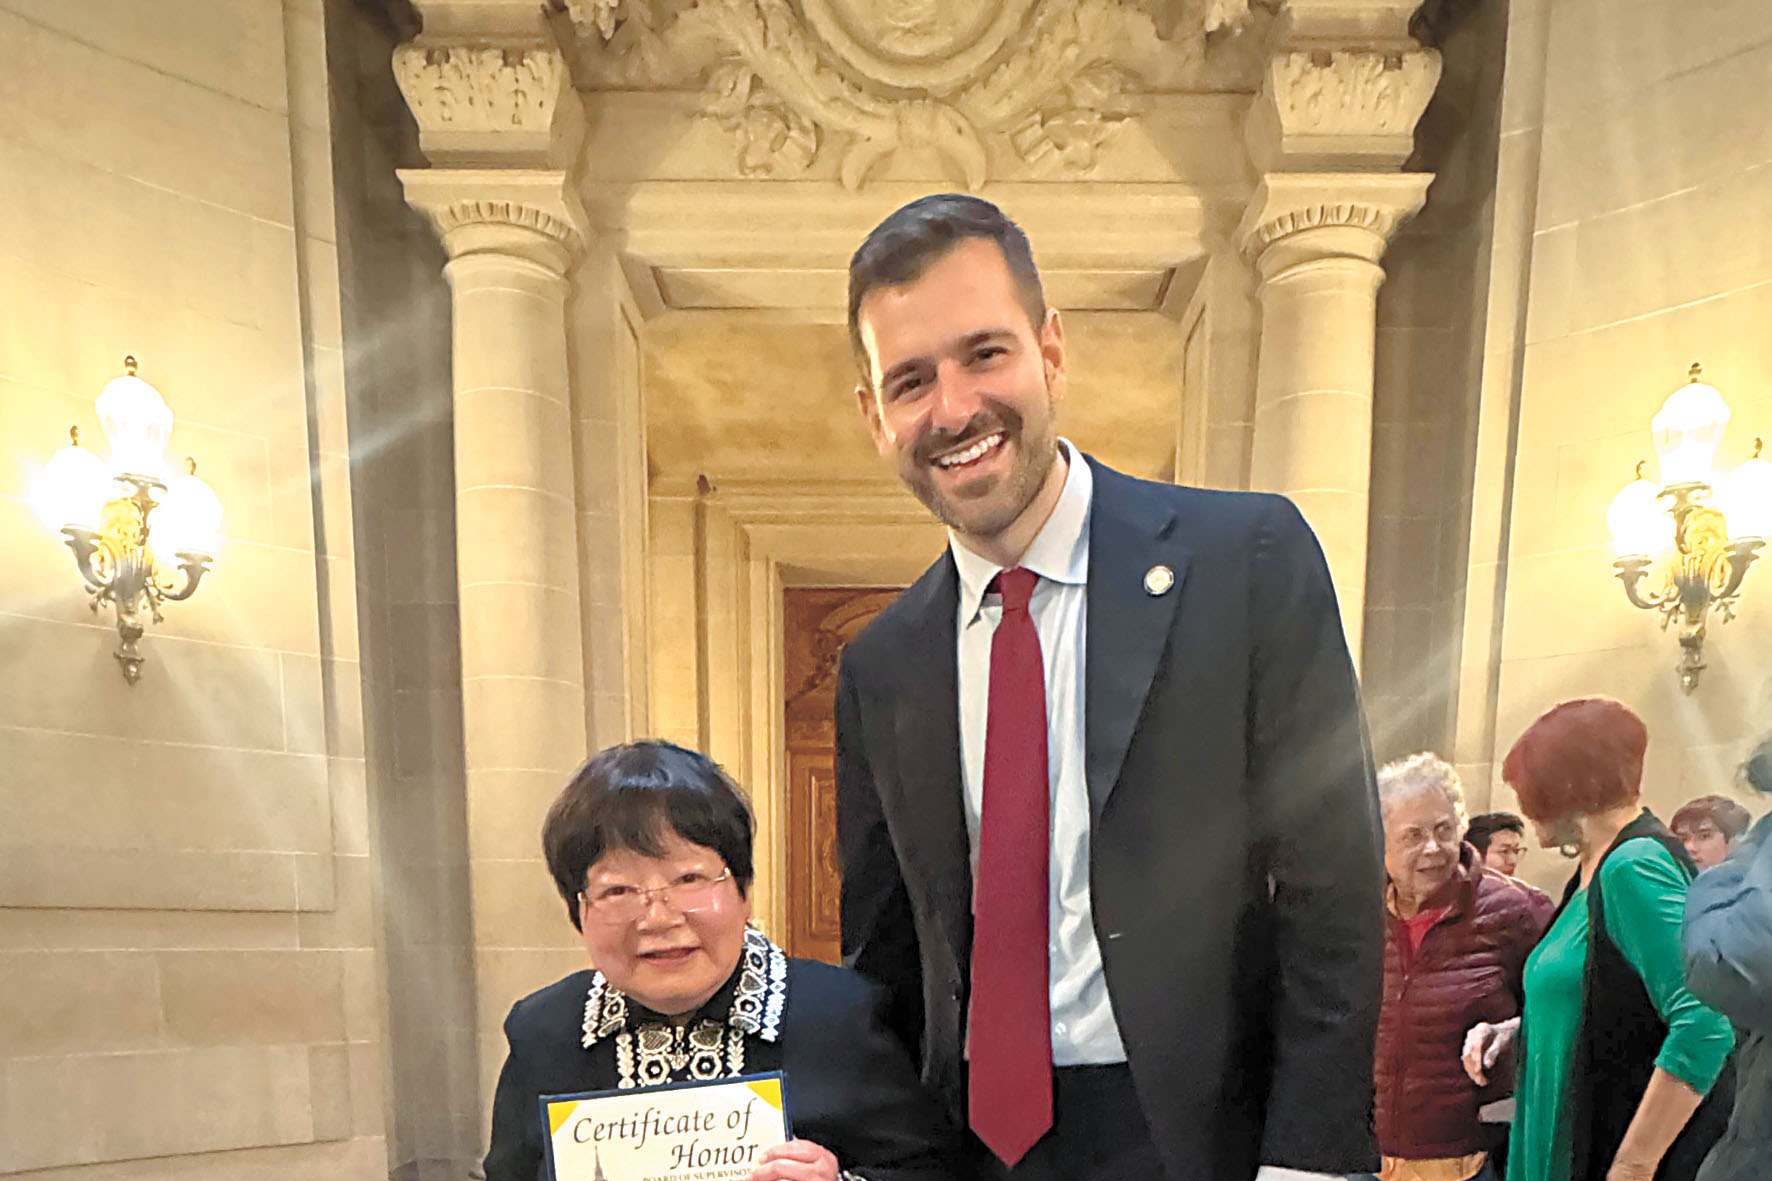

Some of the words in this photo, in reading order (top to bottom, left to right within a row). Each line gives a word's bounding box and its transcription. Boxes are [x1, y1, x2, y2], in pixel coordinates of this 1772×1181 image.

[574, 1107, 715, 1149] Certificate
[727, 1098, 757, 1140] of
[669, 1138, 759, 1170] Honor
[679, 1173, 691, 1181] OF
[694, 1168, 752, 1180] SUPERVISO
